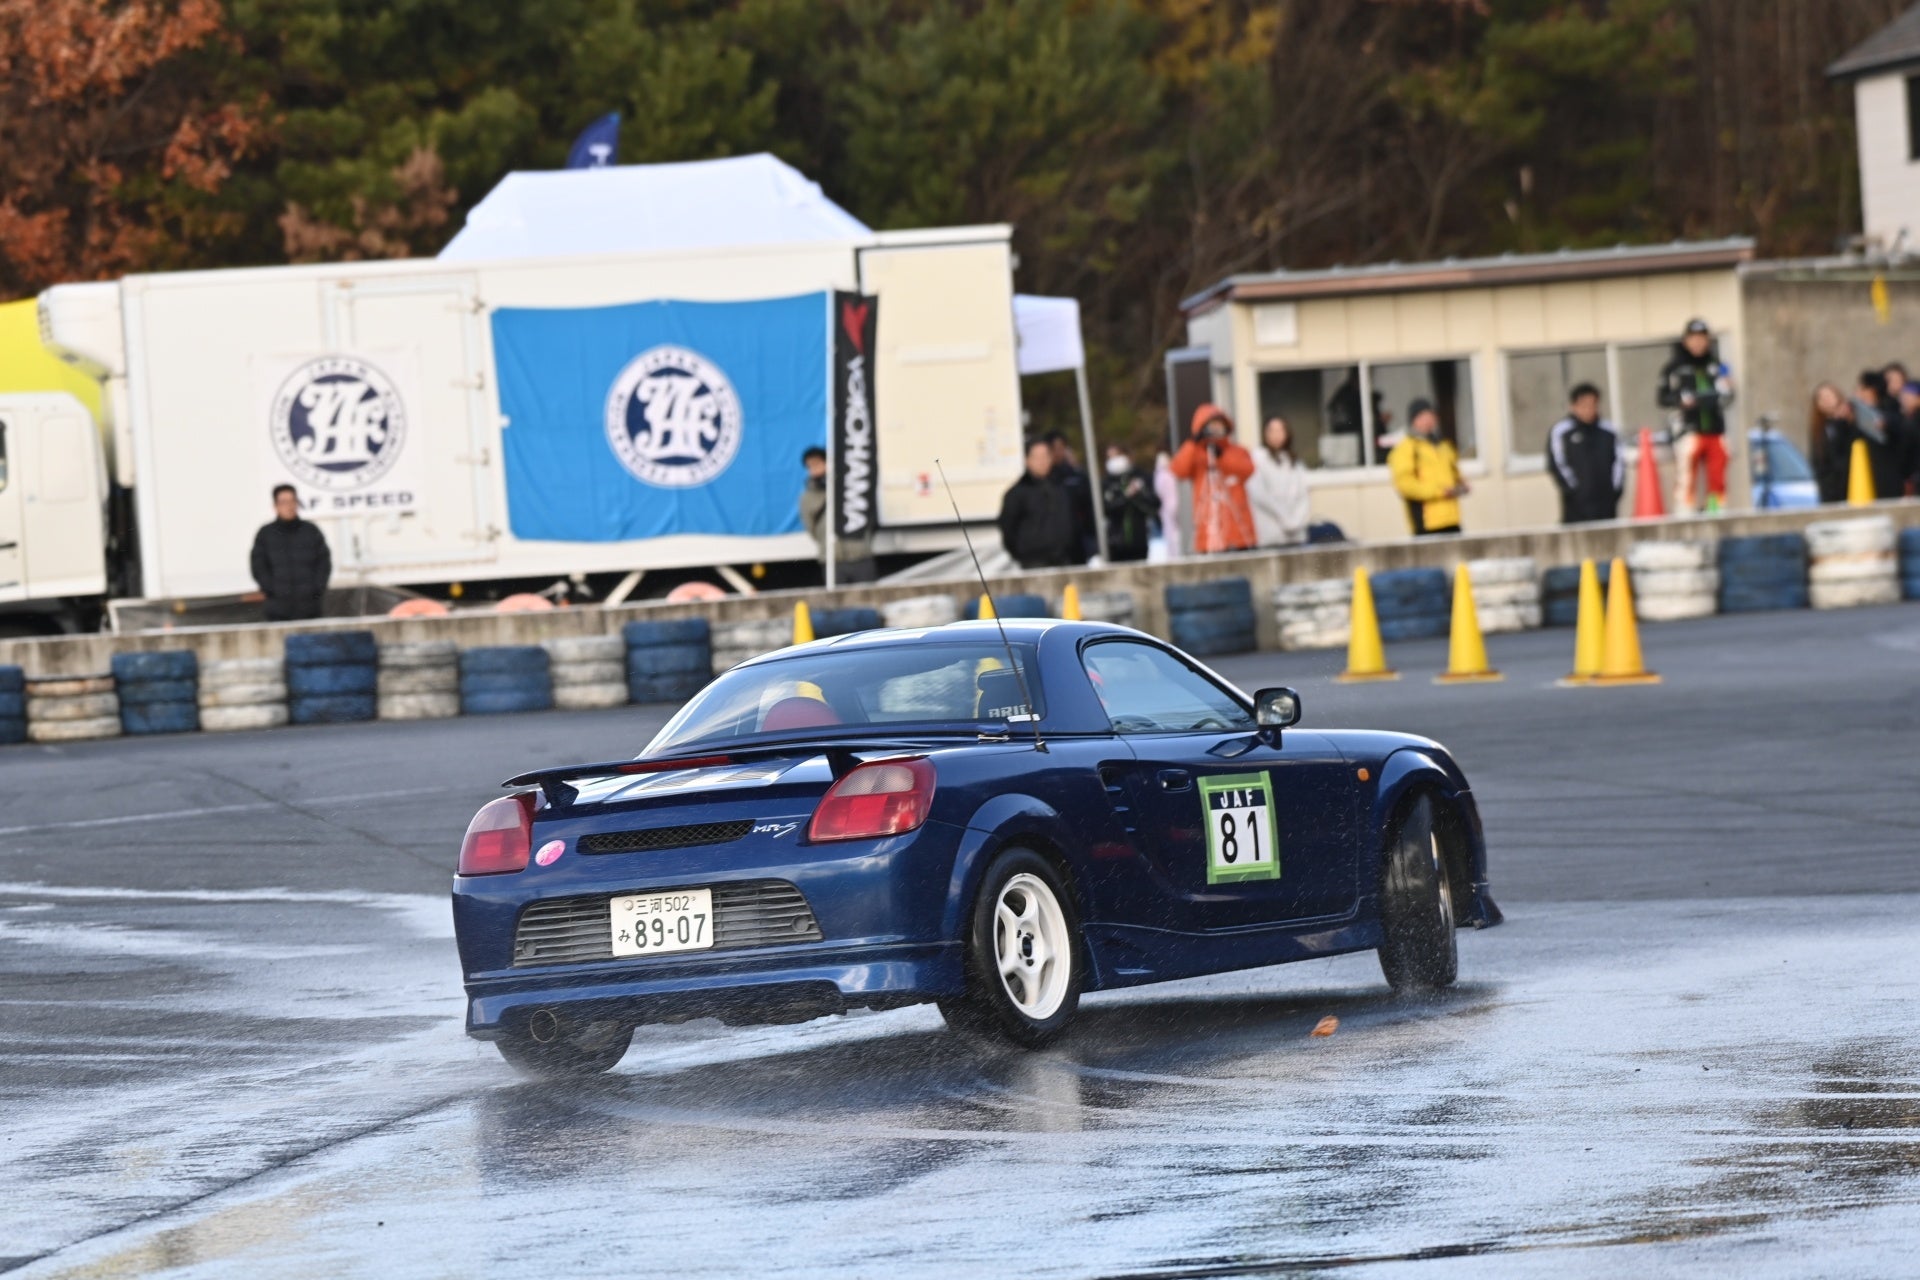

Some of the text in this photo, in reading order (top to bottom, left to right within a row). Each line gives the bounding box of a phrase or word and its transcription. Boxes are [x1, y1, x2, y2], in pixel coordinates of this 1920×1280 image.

[843, 354, 871, 533] YOKOHAMA
[332, 490, 413, 509] SPEED
[1220, 787, 1253, 808] JAF
[1221, 811, 1260, 863] 81
[635, 914, 706, 948] 89-07
